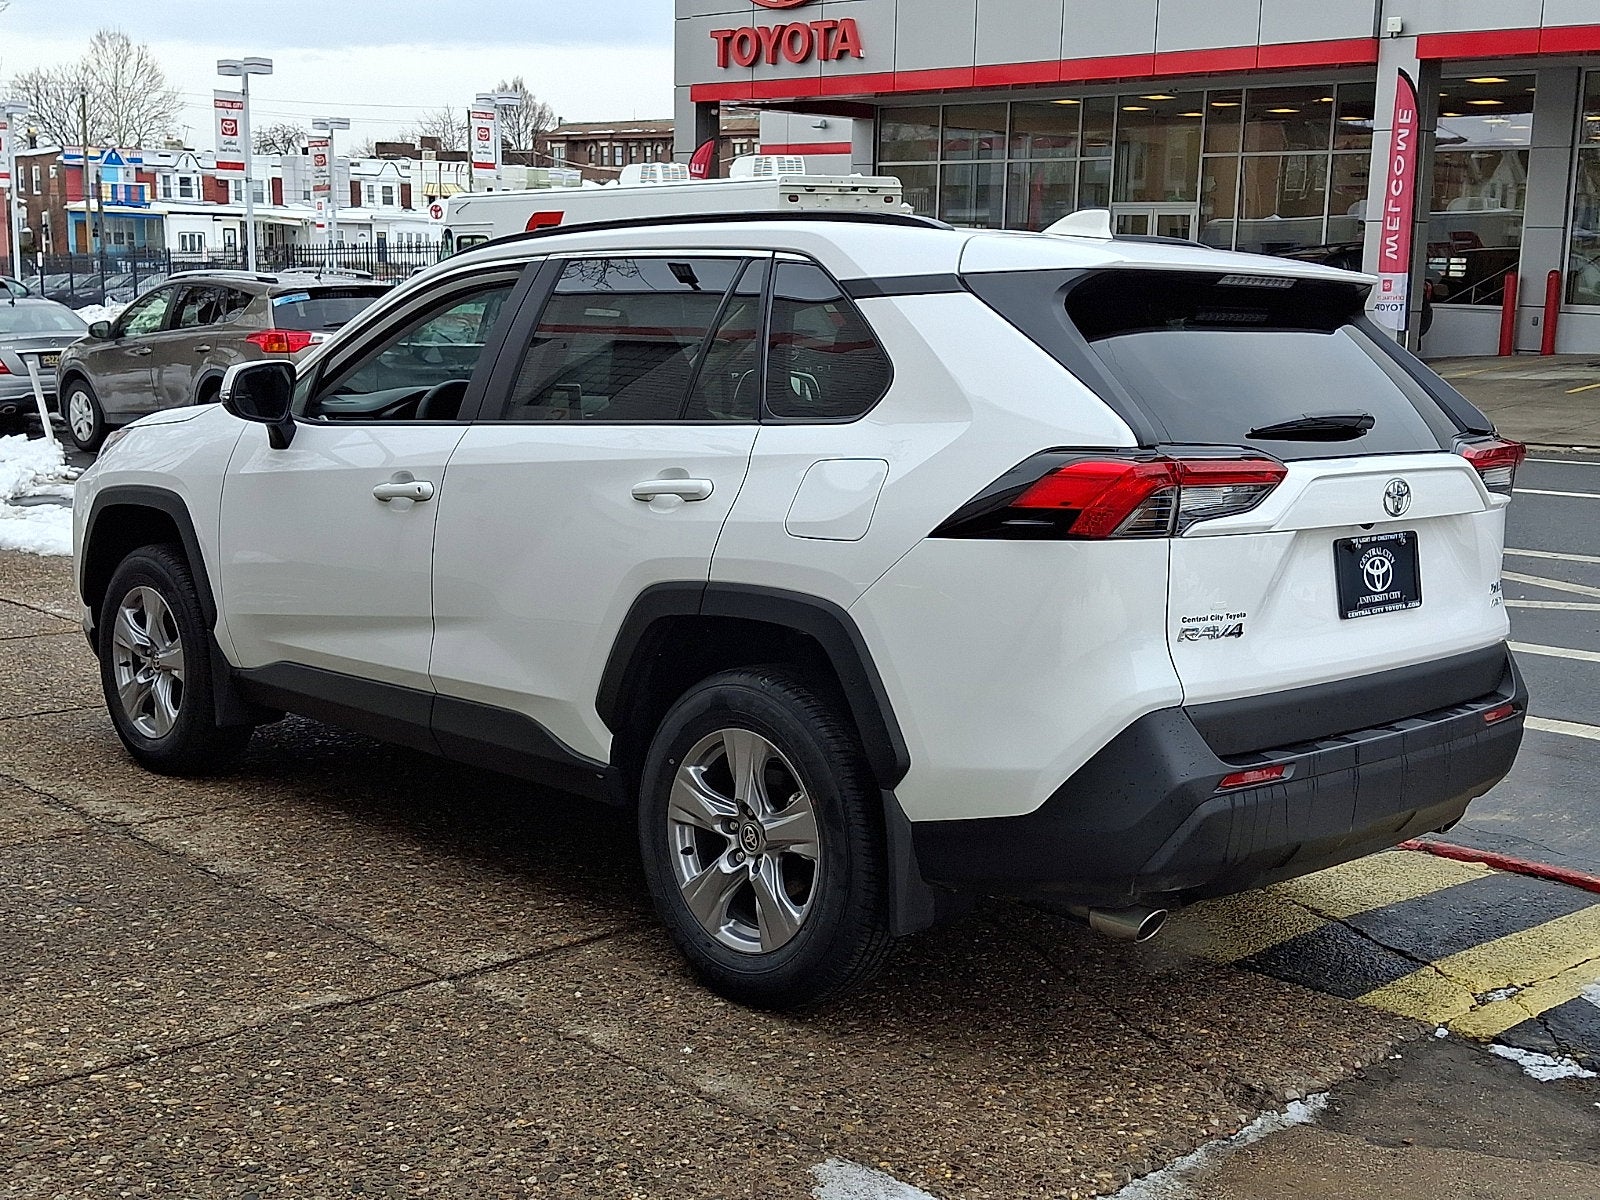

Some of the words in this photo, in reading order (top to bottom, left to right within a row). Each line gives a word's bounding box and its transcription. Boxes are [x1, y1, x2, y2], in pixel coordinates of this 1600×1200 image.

[710, 18, 861, 68] TOYOTA
[1360, 547, 1382, 569] CENTRAL
[1382, 548, 1396, 564] CITY
[1360, 592, 1388, 604] UNIVERSITY
[1388, 590, 1402, 600] CITY
[1182, 615, 1208, 624] Central
[1226, 612, 1246, 620] Toyota
[1348, 609, 1372, 618] CENTRAL
[1177, 622, 1244, 642] RAV4
